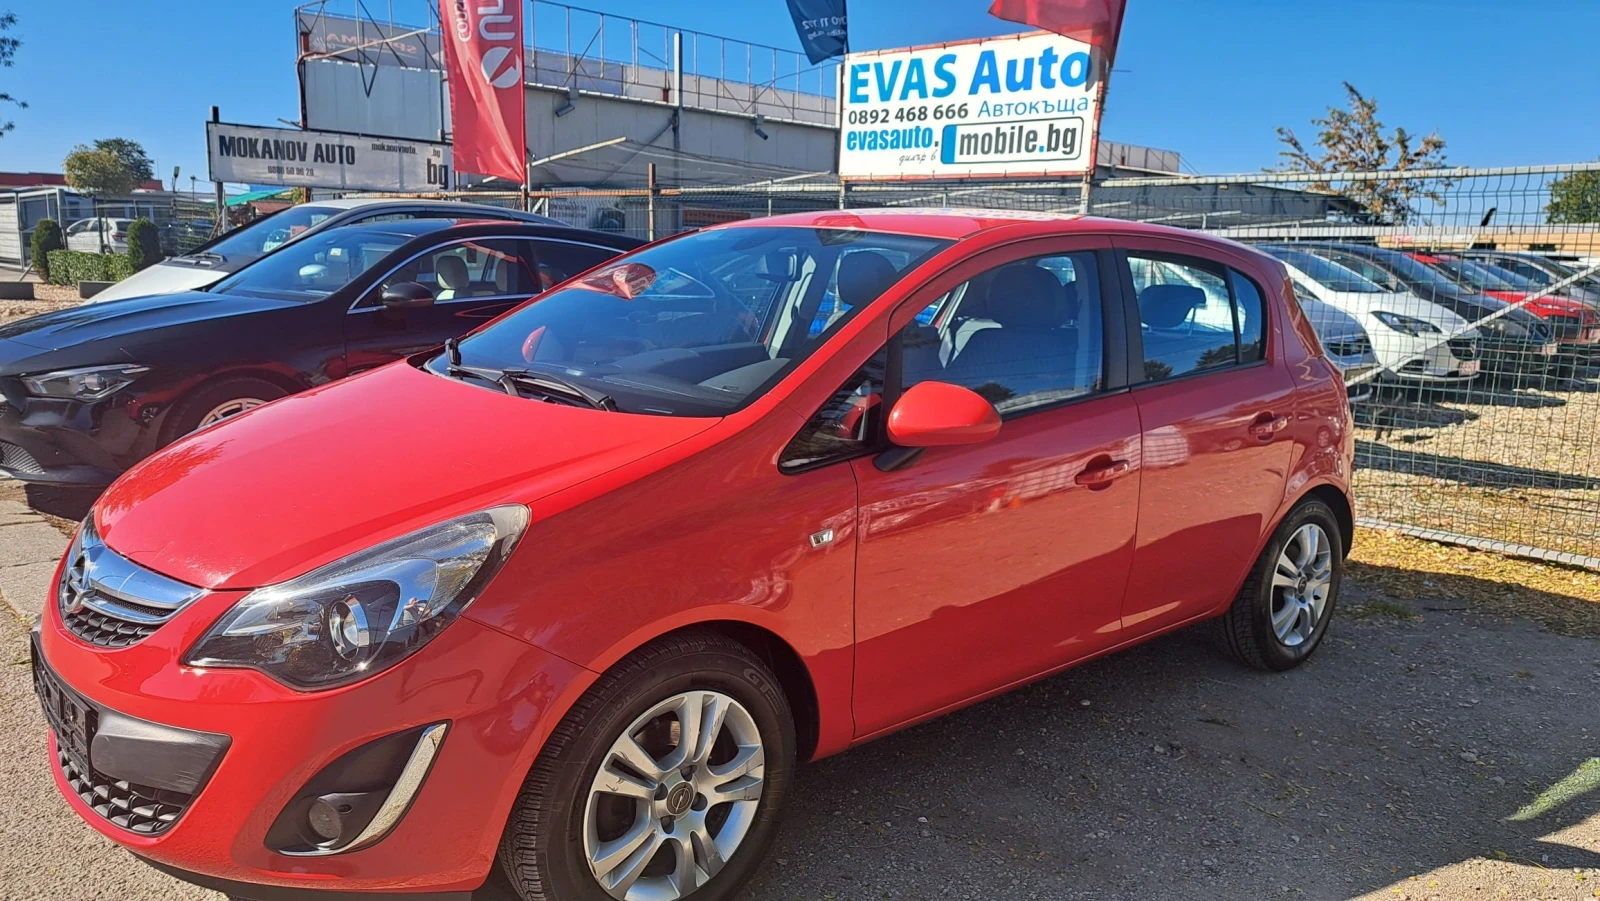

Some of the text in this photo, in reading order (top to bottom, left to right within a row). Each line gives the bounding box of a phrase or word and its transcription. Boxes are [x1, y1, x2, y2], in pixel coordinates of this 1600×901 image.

[849, 46, 1092, 104] EVAS Auto
[849, 102, 969, 125] 0892 468 666
[977, 97, 1089, 119] Автокъща
[219, 135, 356, 165] MOKANOV AUTO
[958, 123, 1078, 156] mobile.bg
[427, 158, 449, 190] bg
